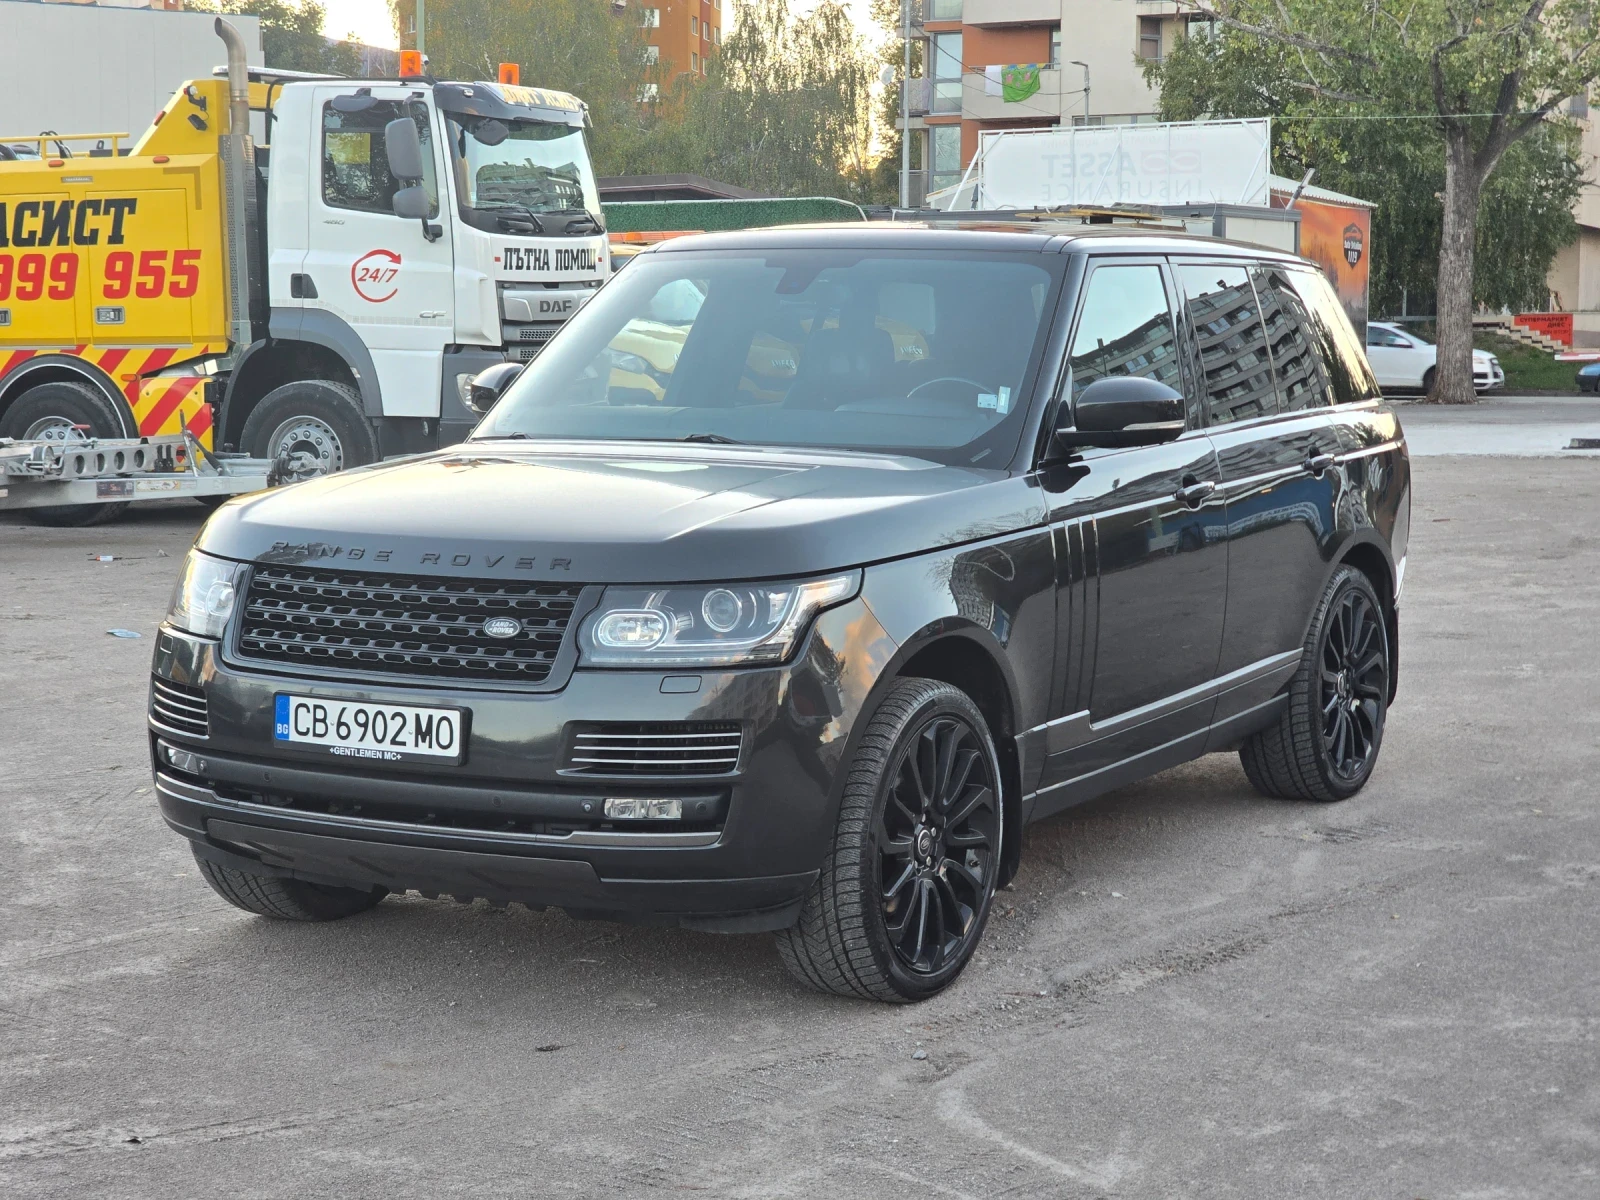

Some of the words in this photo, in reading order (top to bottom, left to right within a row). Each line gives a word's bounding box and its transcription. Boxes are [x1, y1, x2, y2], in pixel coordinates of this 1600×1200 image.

[503, 247, 550, 271] ПЪТНА
[555, 248, 597, 272] ПОМОЩ
[103, 249, 202, 299] 955
[357, 267, 399, 283] 24/7
[540, 300, 572, 313] DAF
[270, 540, 393, 562] RANGE
[420, 552, 572, 571] ROVER
[276, 723, 289, 735] BG
